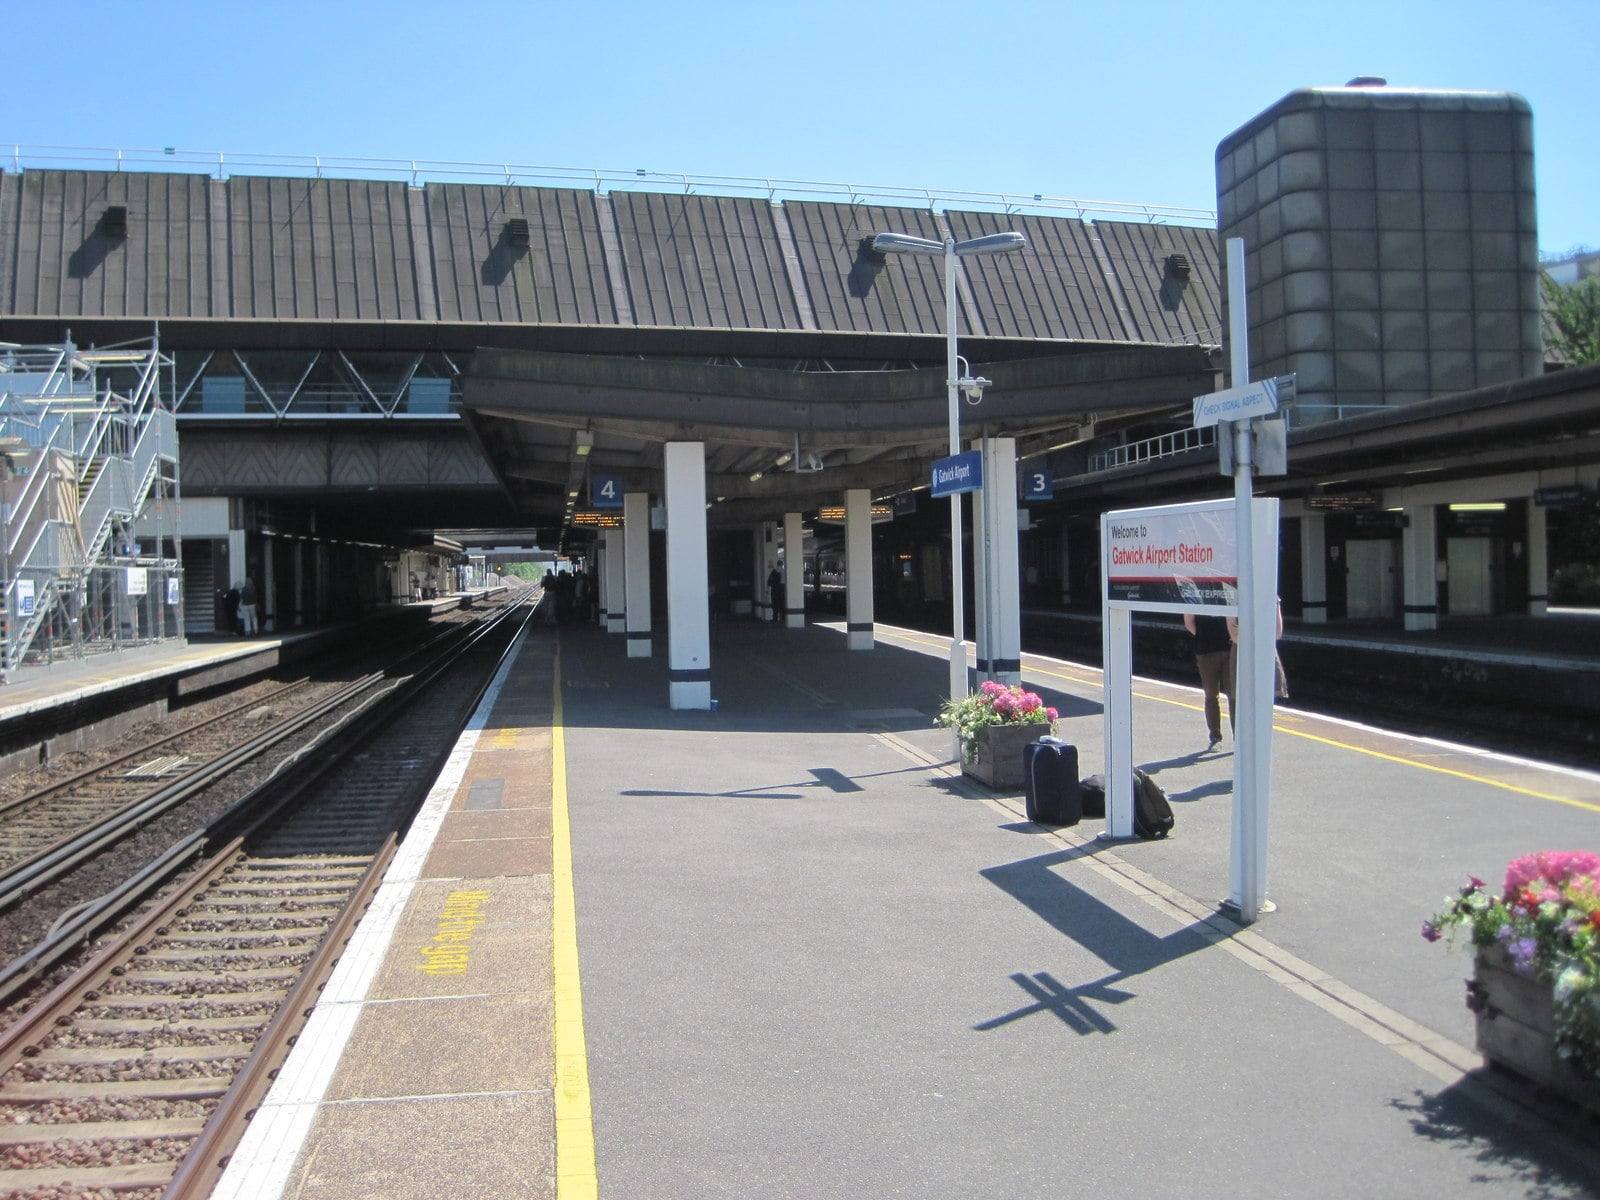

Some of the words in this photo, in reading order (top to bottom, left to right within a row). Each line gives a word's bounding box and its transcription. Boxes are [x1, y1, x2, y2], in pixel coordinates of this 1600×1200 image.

[939, 466, 955, 483] Gatwick
[955, 464, 970, 481] Airport
[1033, 474, 1045, 492] 3
[601, 480, 616, 499] 4
[1111, 526, 1139, 538] Welcome
[1140, 525, 1146, 537] to
[1112, 546, 1143, 564] Gatwick
[1146, 545, 1175, 568] Airport
[1179, 543, 1212, 563] Station
[416, 945, 470, 976] gap
